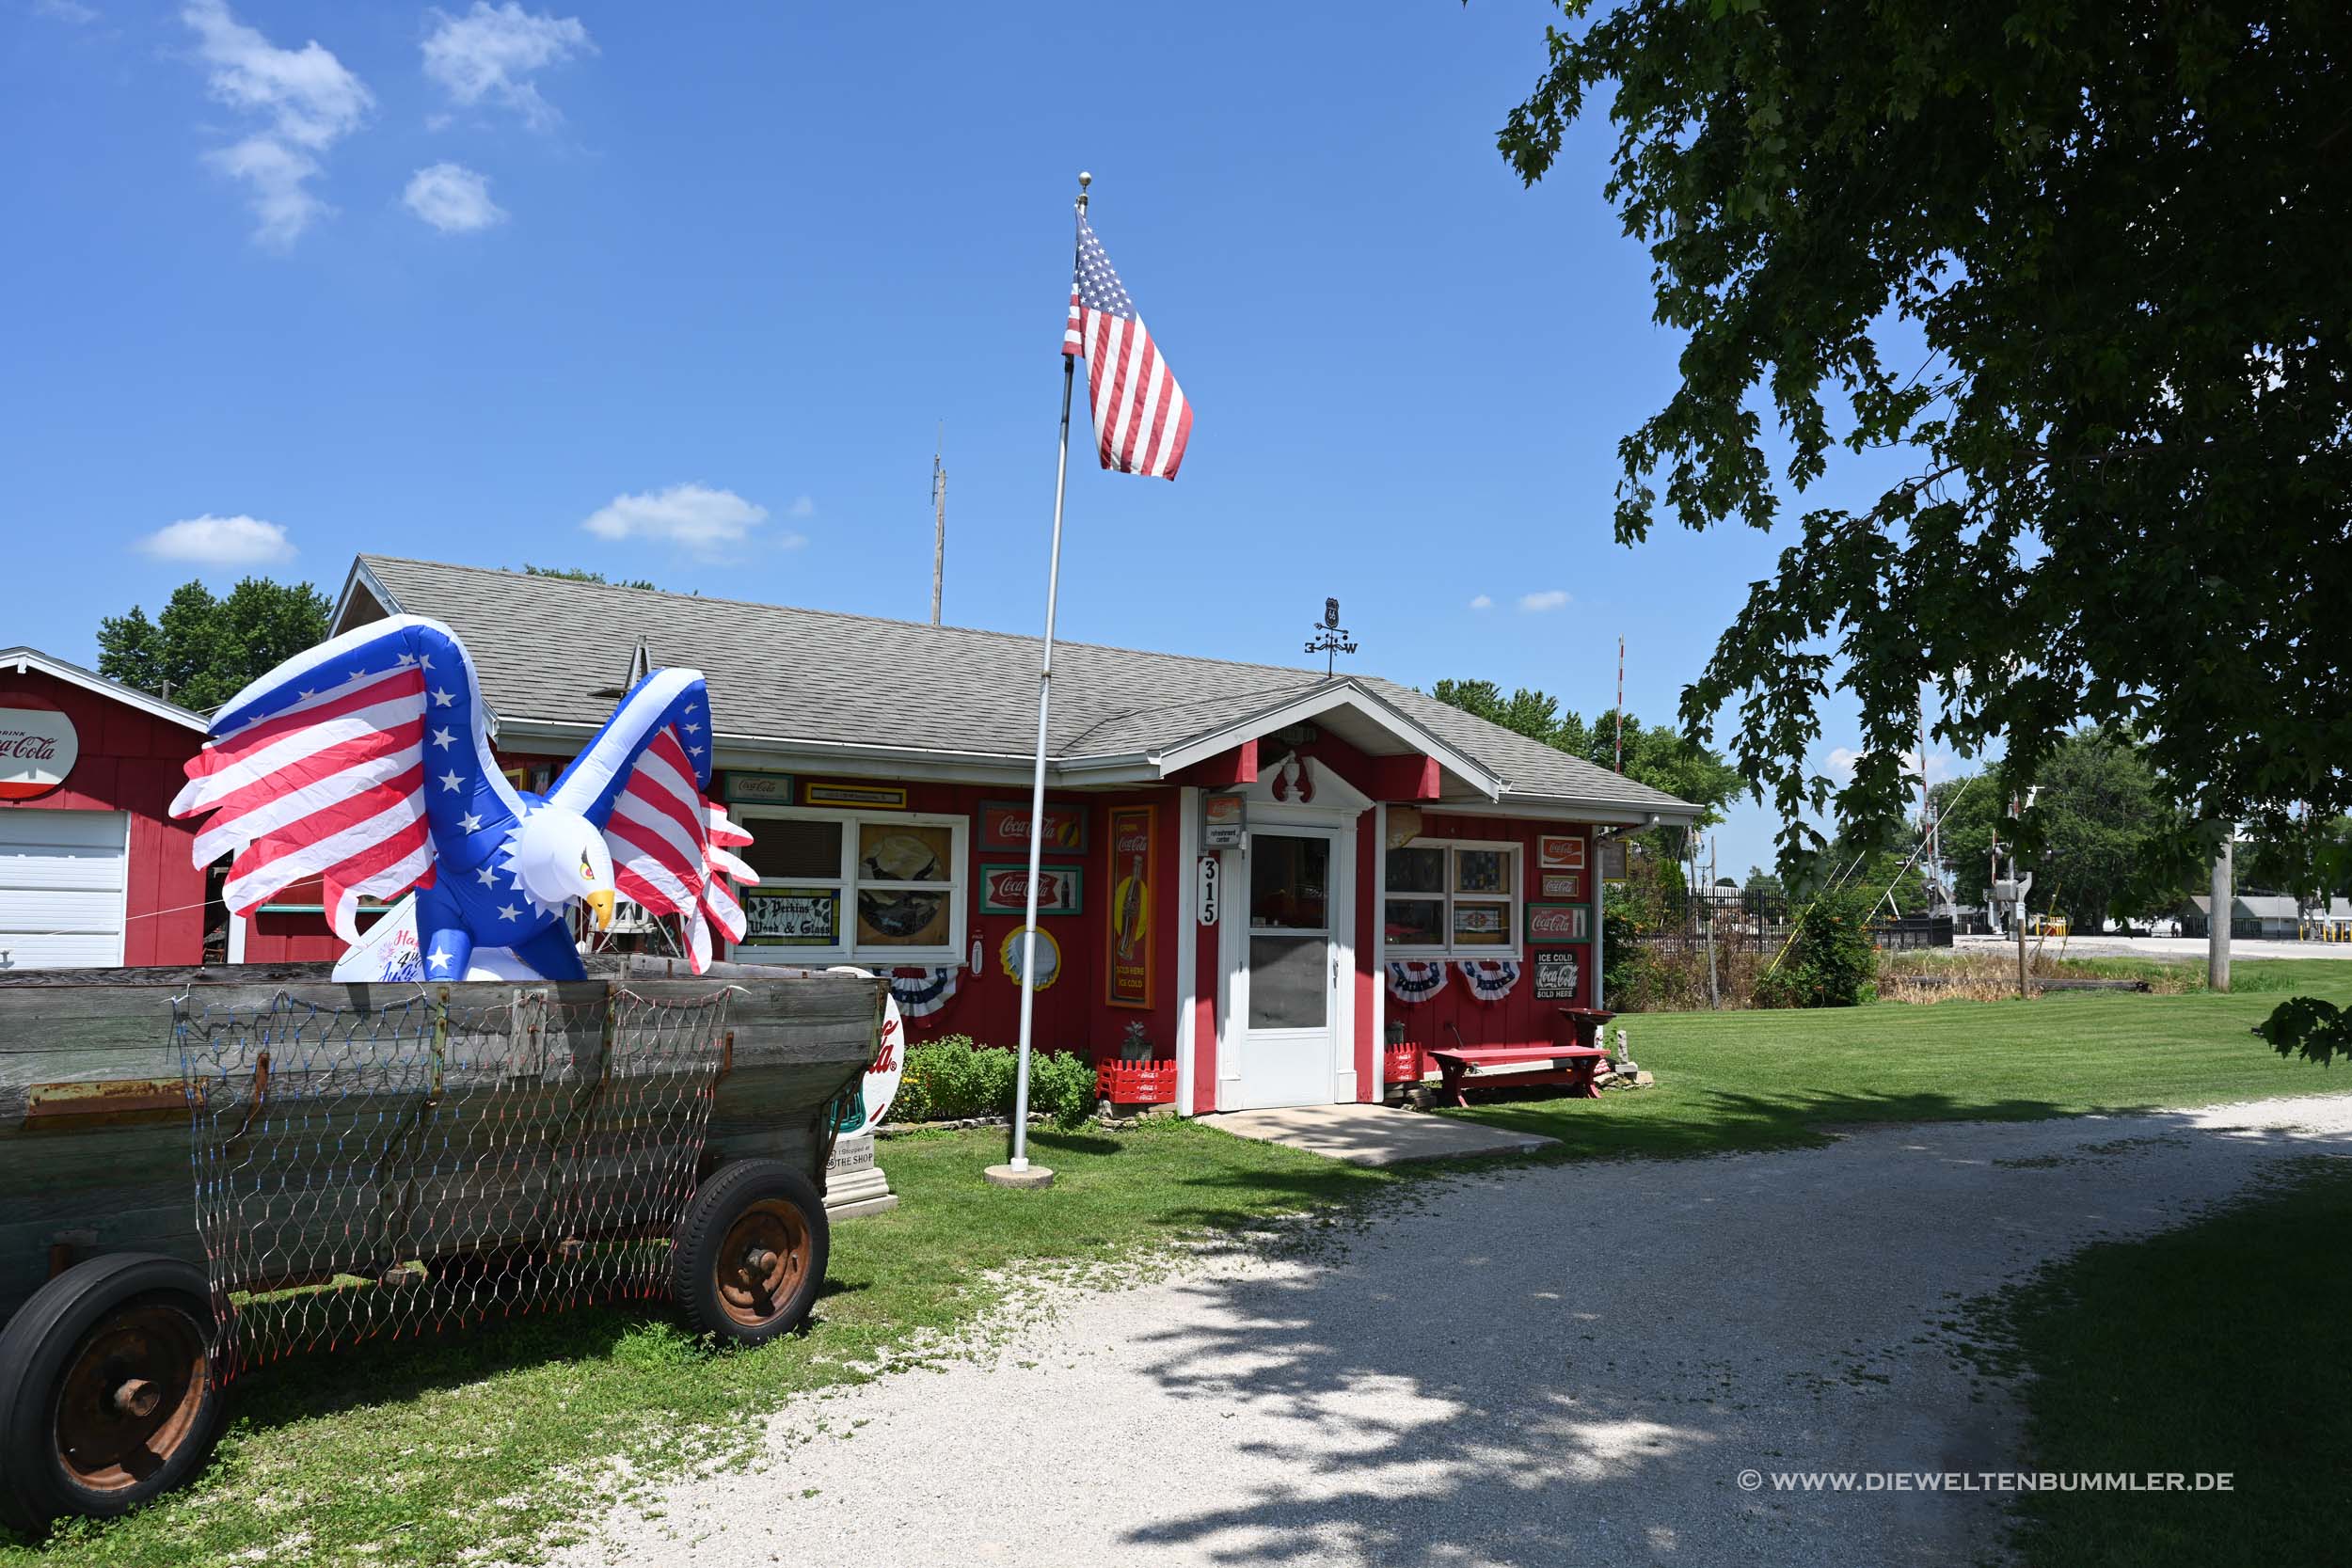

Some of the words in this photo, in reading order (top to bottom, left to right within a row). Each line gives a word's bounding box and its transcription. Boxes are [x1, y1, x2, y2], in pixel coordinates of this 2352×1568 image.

[1204, 861, 1216, 922] 315
[771, 899, 809, 917] Perkins
[749, 920, 779, 933] Wood
[784, 922, 795, 933] &
[800, 920, 830, 933] Glass
[1538, 954, 1551, 962] ICE
[1553, 954, 1573, 962] COLD
[1555, 990, 1573, 998] HERE
[835, 1156, 851, 1167] THE
[852, 1152, 873, 1164] SHOP
